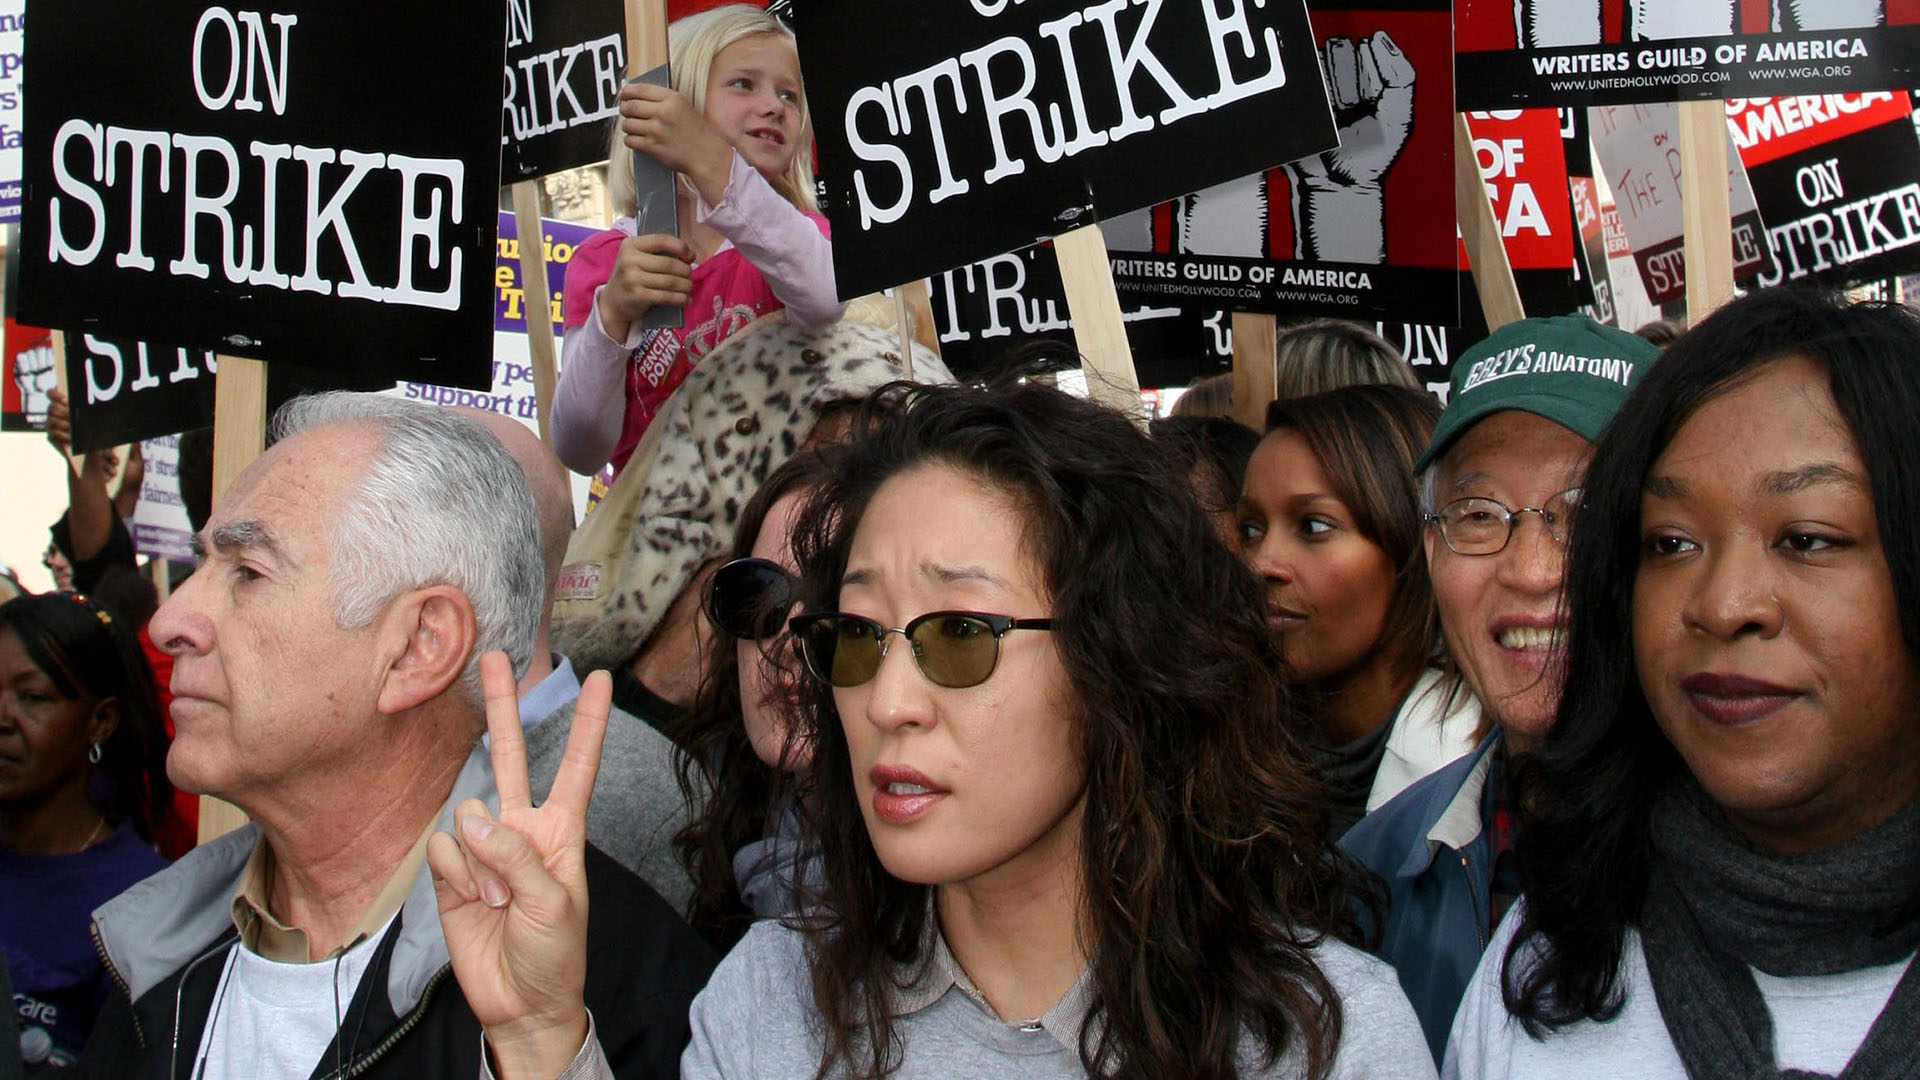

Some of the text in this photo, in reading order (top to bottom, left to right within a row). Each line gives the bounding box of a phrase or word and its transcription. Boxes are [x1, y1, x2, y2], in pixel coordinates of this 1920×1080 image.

[505, 0, 532, 48] N
[193, 6, 298, 115] ON
[1532, 38, 1868, 75] WRITERS GUILD OF AMERICA
[1551, 65, 1852, 91] WWW.UNITEDHOLLYWOOD.COM WWW.WGA.ORG
[845, 0, 1286, 231] STRIKE
[1473, 138, 1524, 179] OF
[1795, 158, 1845, 208] ON
[49, 119, 464, 311] STRIKE
[1618, 168, 1662, 218] THE
[1183, 263, 1242, 282] GUILD
[1249, 266, 1275, 284] OF
[1282, 268, 1372, 290] AMERICA
[1276, 290, 1359, 305] WWW.WGA.ORG
[639, 328, 674, 378] PENCILS
[647, 338, 681, 388] DOWN
[1460, 344, 1634, 395] GREY'S ANATOMY
[405, 381, 514, 415] support
